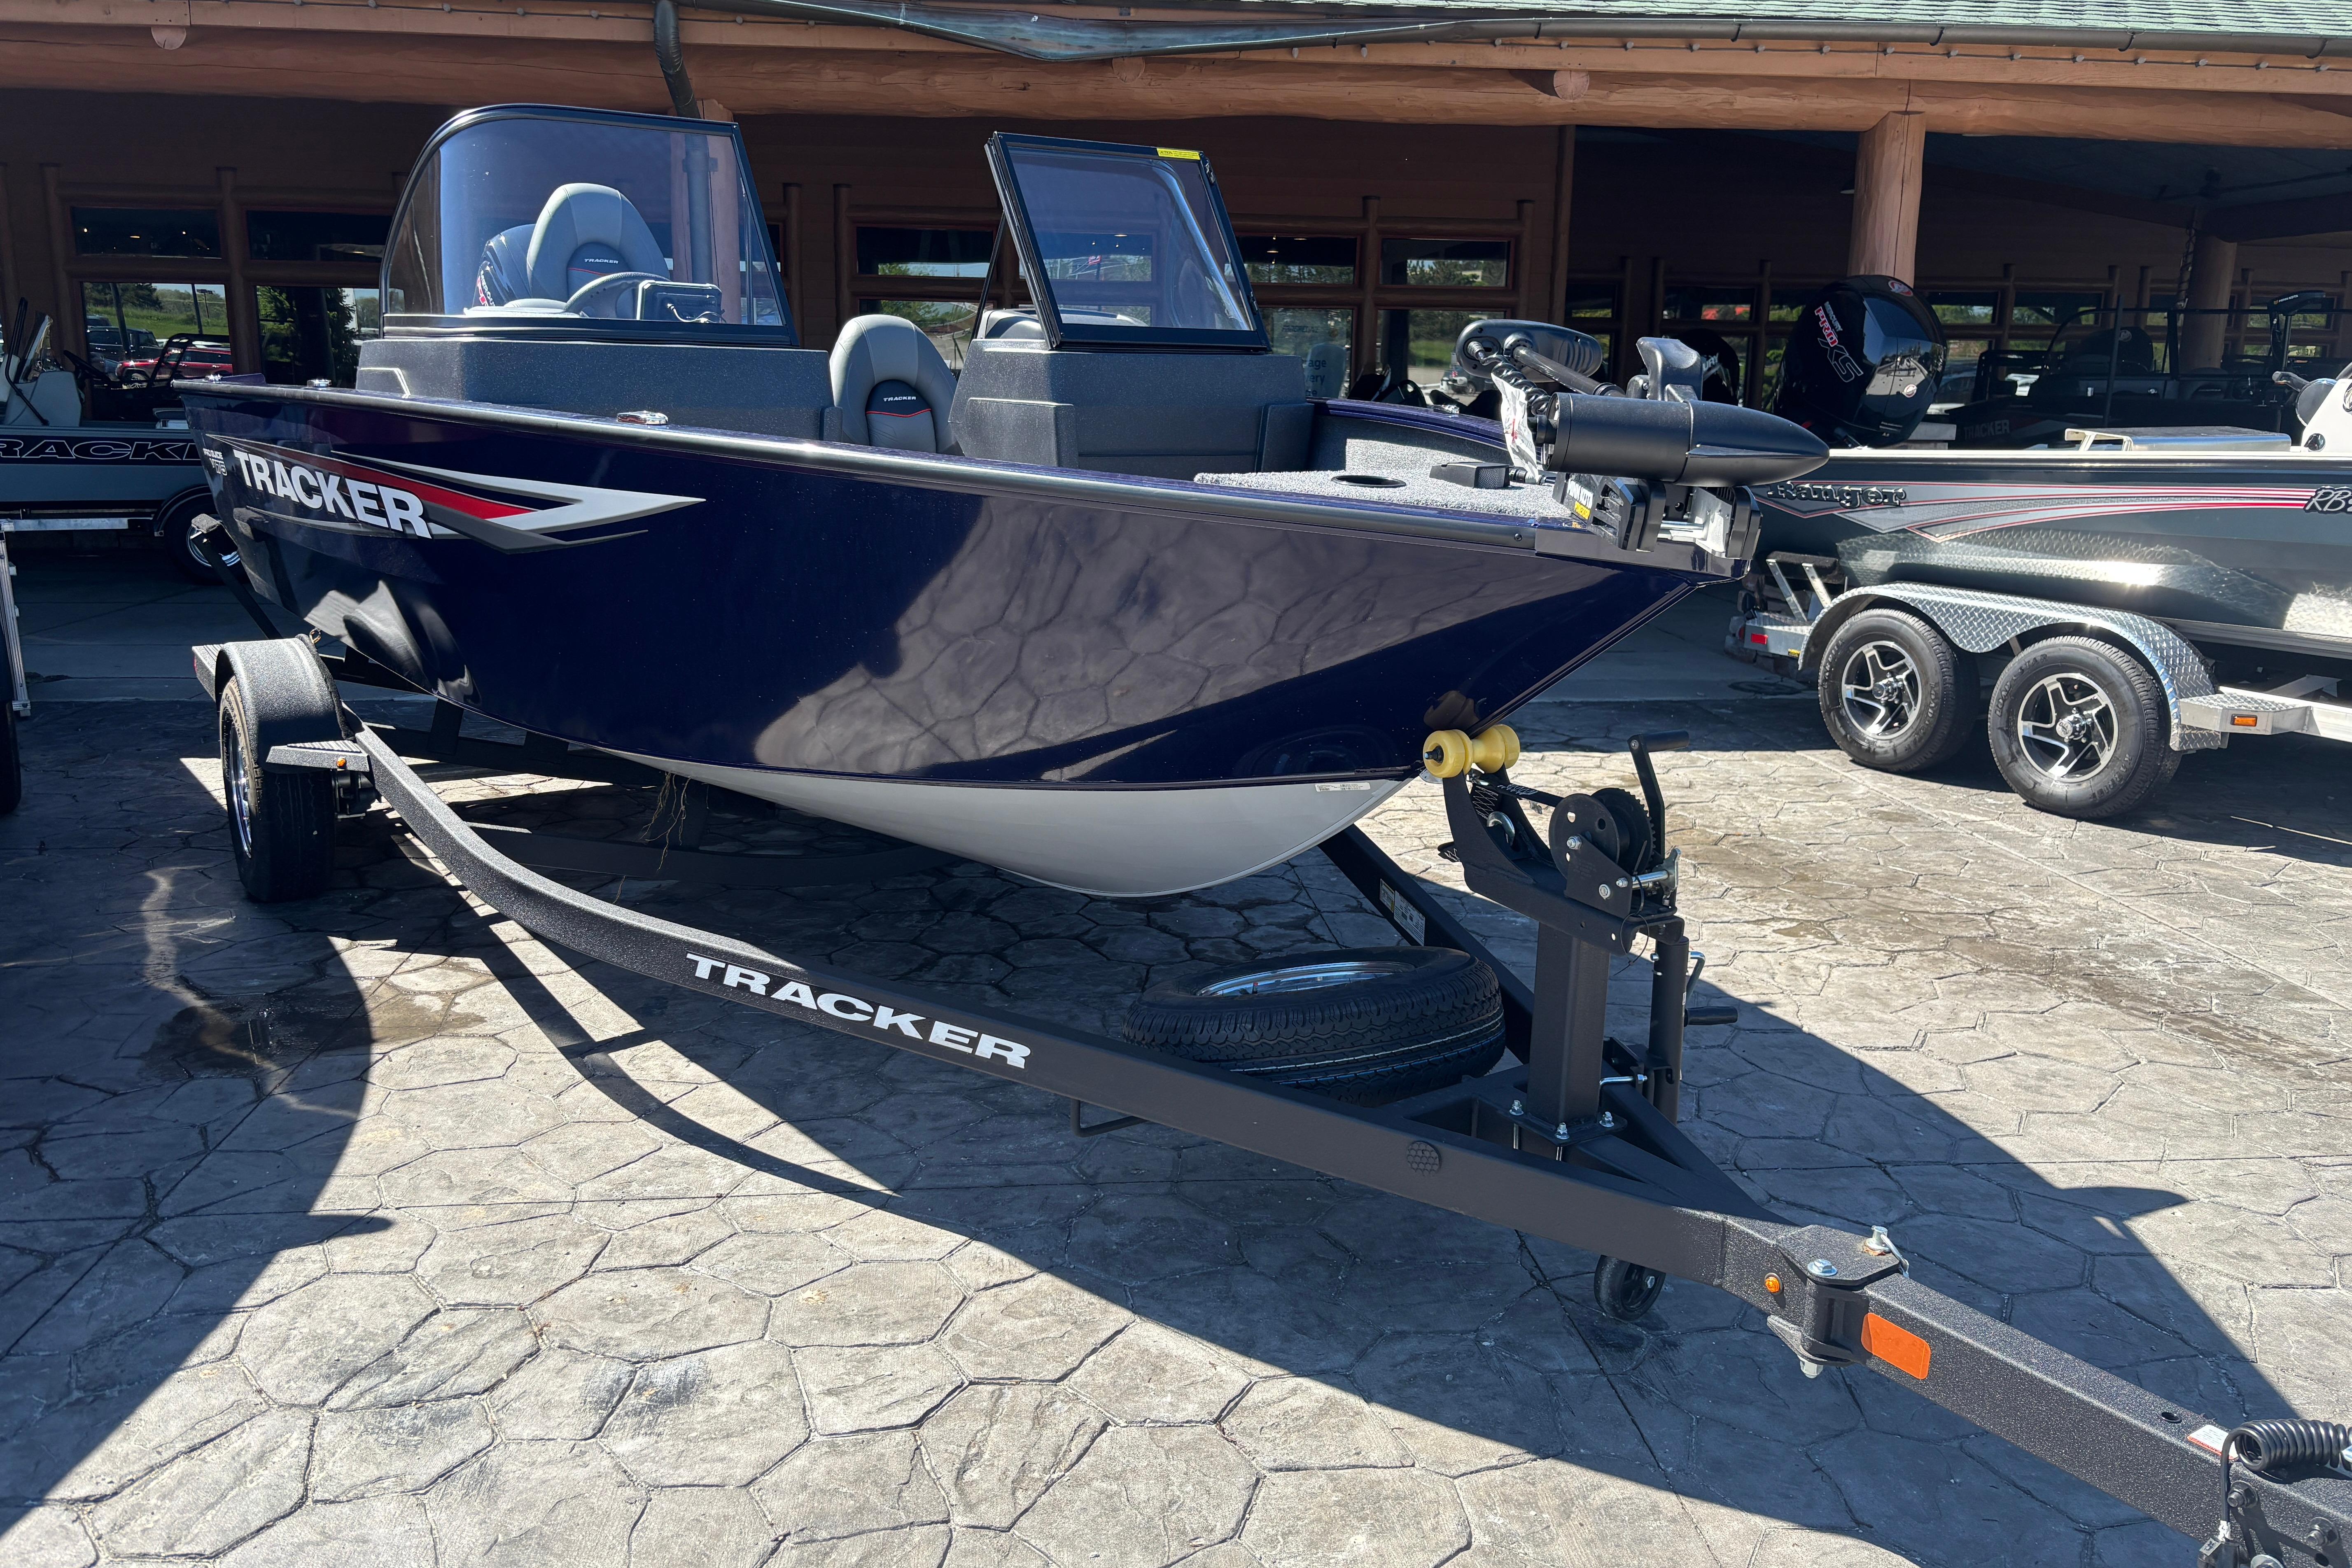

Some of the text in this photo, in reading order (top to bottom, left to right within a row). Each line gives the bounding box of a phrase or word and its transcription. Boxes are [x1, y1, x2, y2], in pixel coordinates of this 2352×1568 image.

[1814, 306, 1839, 347] PRO
[1824, 301, 1843, 332] MERCURY
[1817, 337, 1864, 383] XS
[1963, 419, 2010, 440] TRACKER
[233, 449, 432, 539] TRACKER
[1768, 481, 1906, 509] Ranger
[686, 952, 1031, 1069] TRACKER
[2196, 1440, 2222, 1454] ARNING
